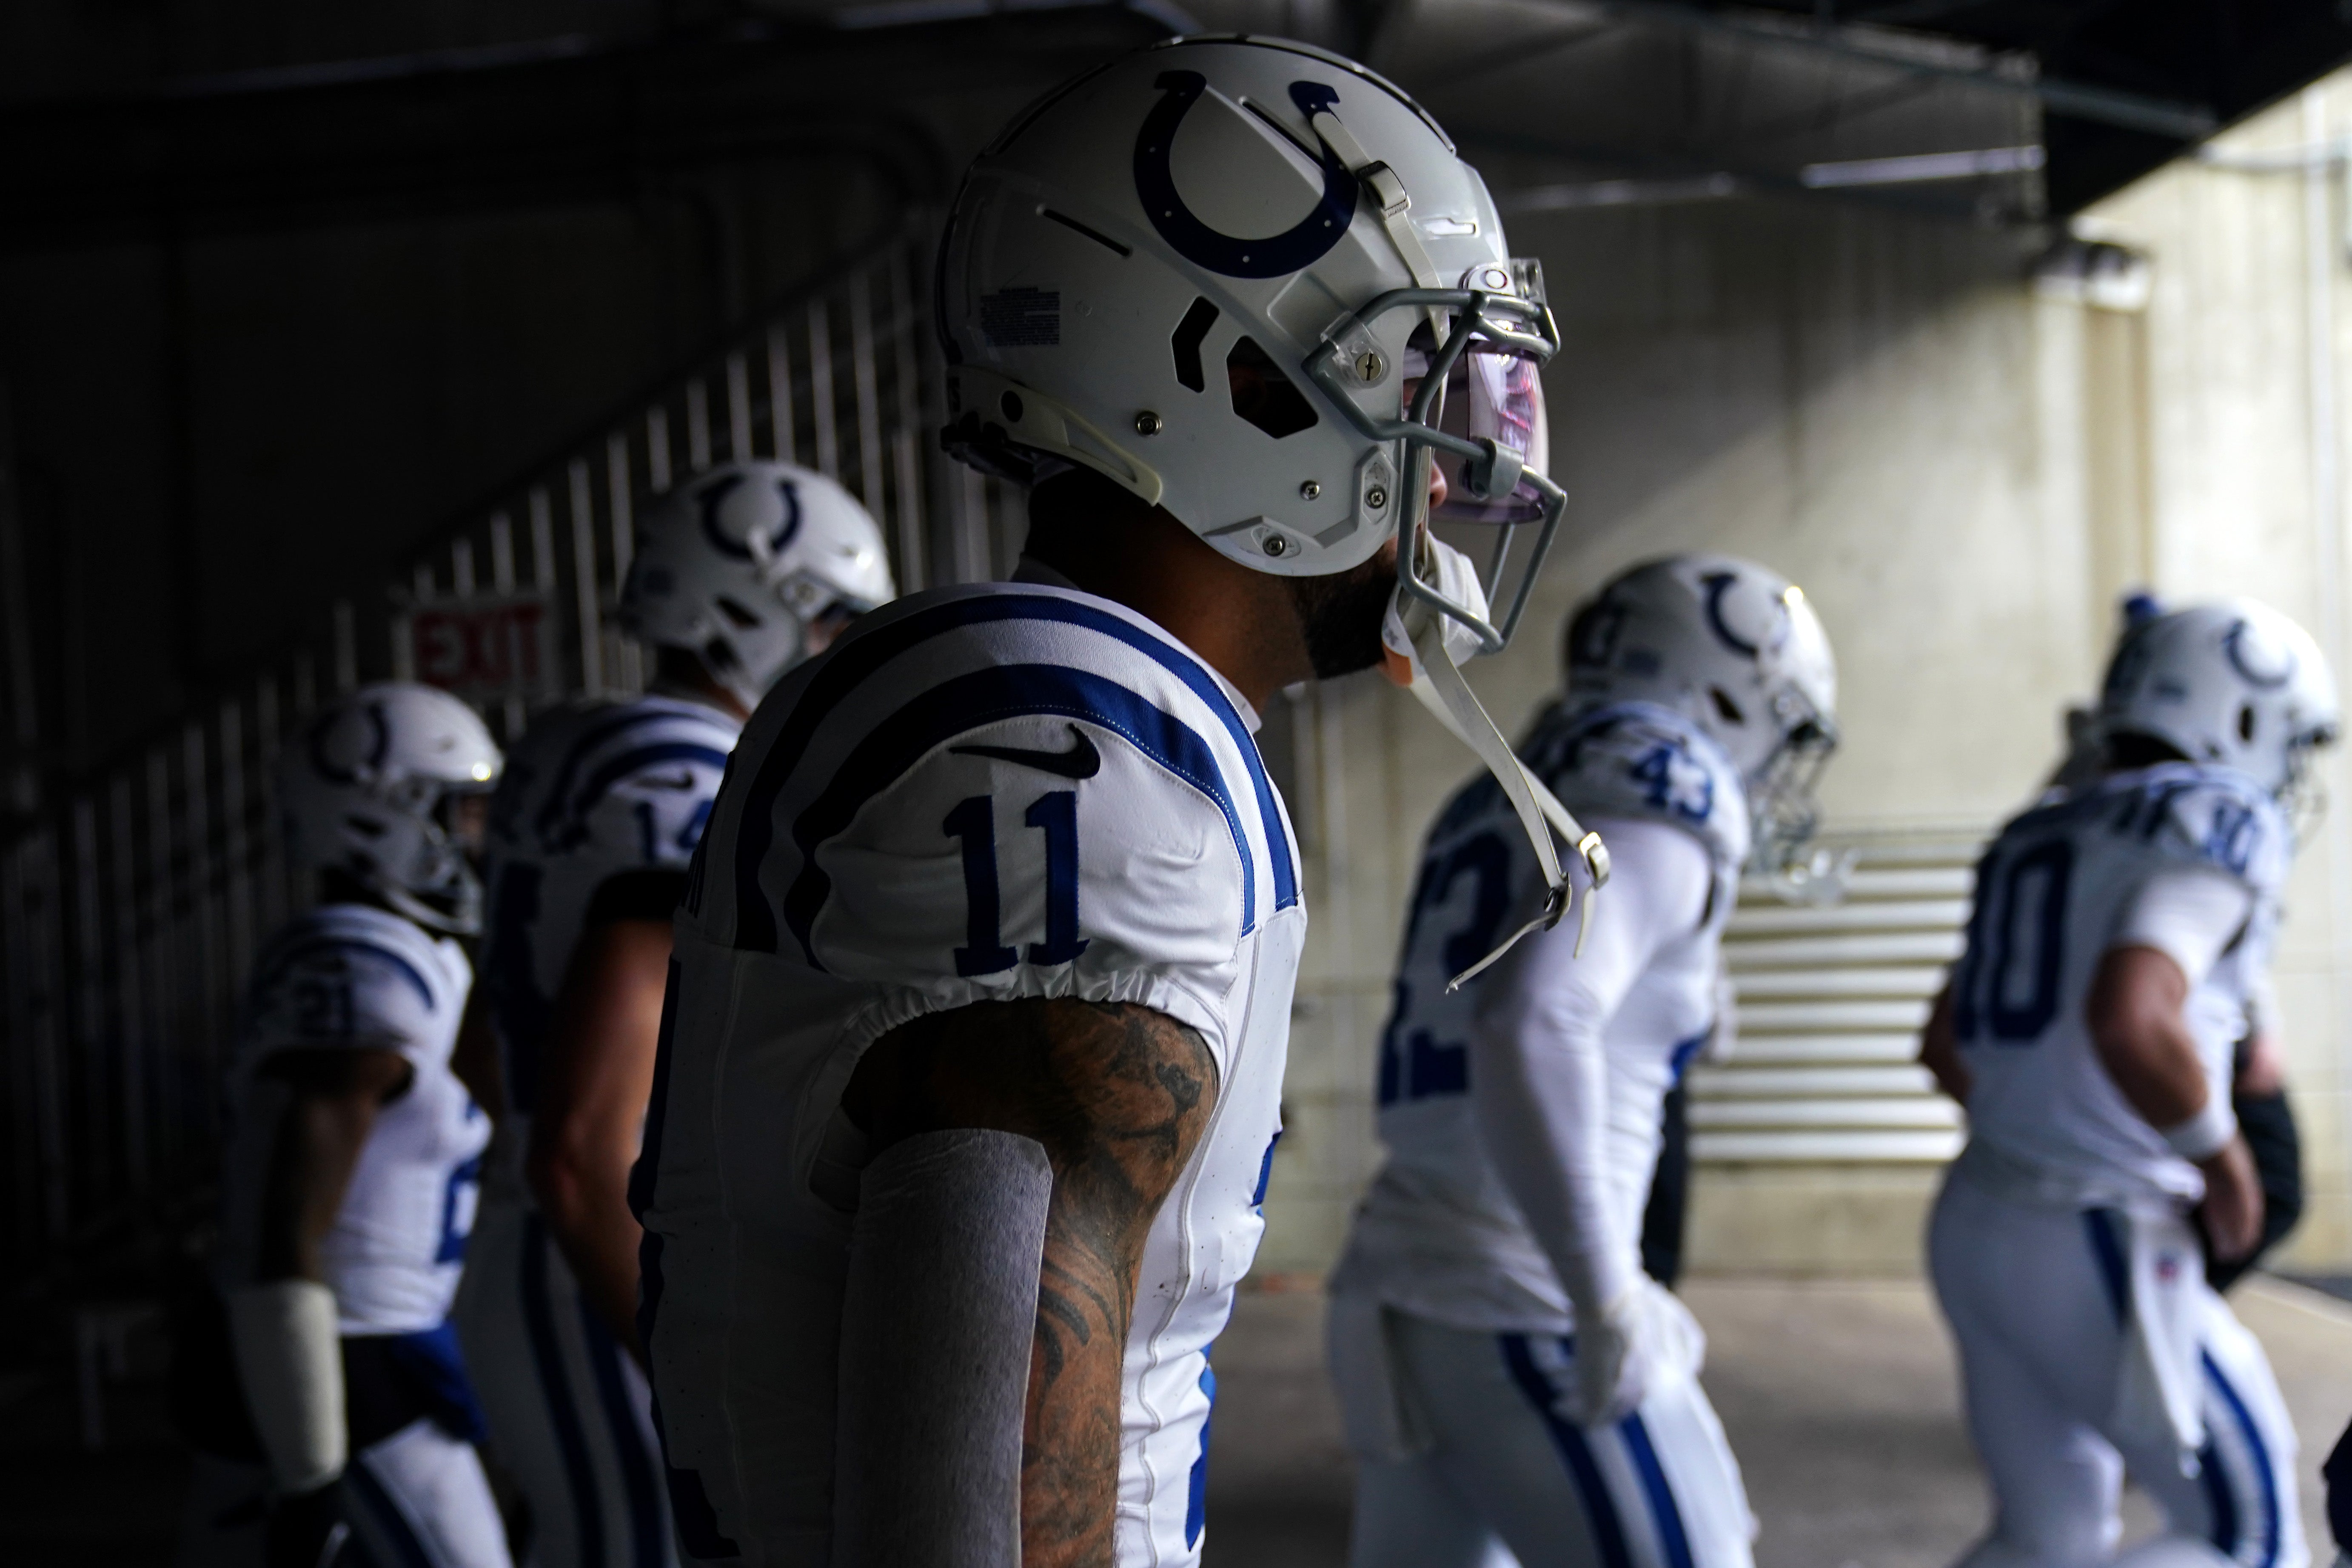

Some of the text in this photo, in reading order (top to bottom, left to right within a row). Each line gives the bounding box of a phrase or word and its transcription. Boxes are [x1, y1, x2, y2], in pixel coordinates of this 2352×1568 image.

[414, 603, 540, 688] EXIT
[1632, 748, 1712, 821] 43
[943, 791, 1090, 977] 11
[296, 979, 352, 1035] 21
